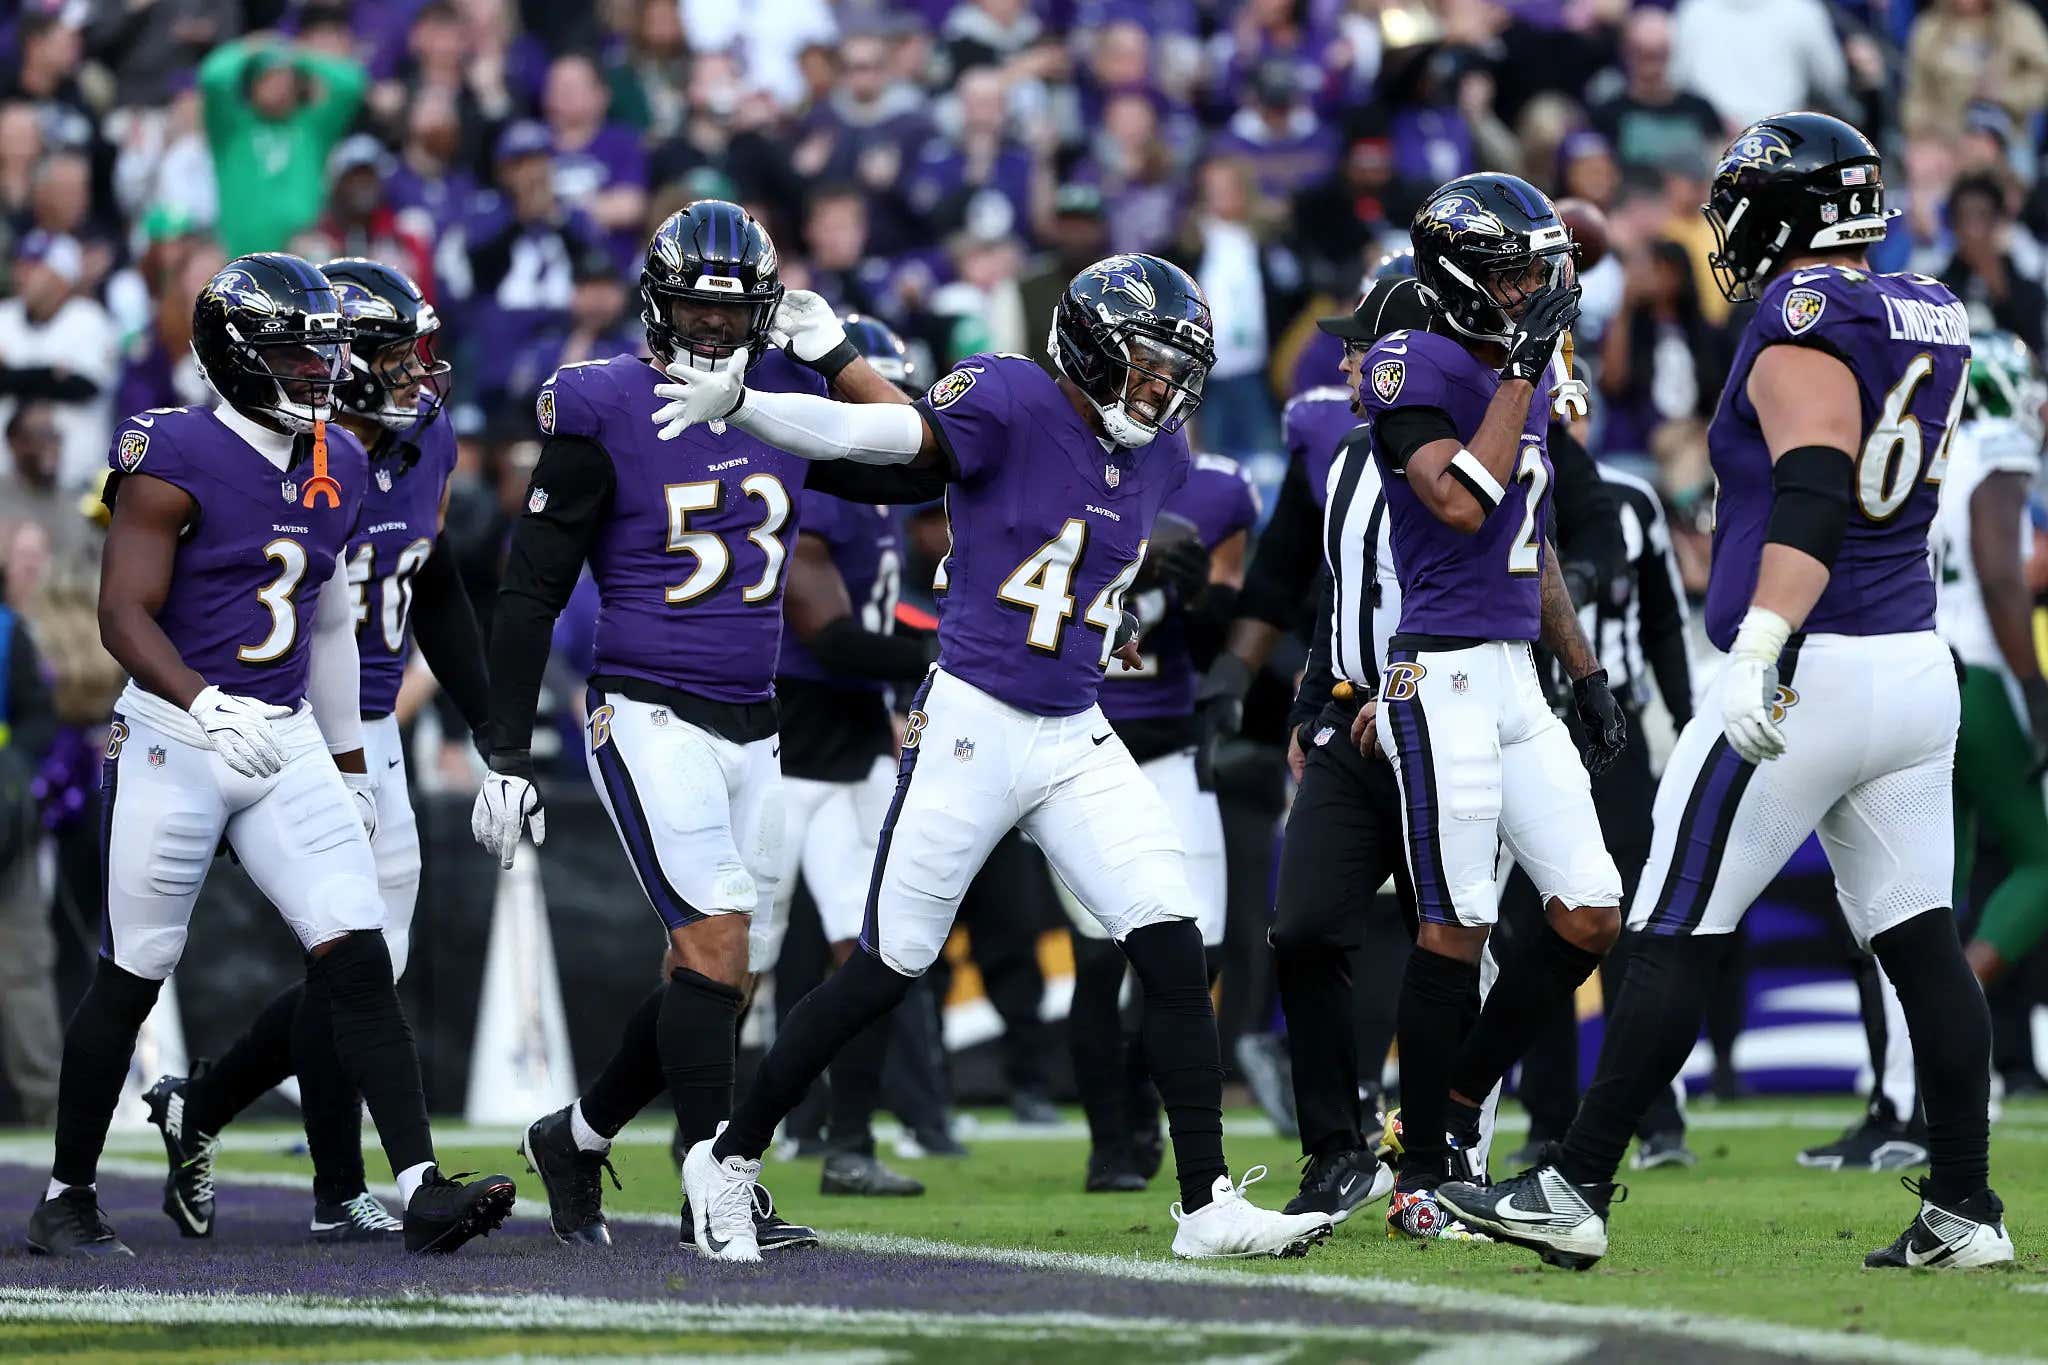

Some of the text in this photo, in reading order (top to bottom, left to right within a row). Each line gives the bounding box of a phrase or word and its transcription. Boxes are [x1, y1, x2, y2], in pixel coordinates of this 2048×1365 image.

[1856, 352, 1971, 522] 64
[707, 457, 749, 472] RAVENS
[368, 521, 408, 535] RAVENS
[1085, 504, 1121, 522] RAVENS
[1507, 444, 1549, 573] 2
[271, 523, 309, 535] RAVENS
[663, 472, 790, 603] 53
[236, 537, 308, 663] 3
[997, 518, 1149, 666] 44
[1384, 661, 1427, 701] B
[105, 721, 130, 760] B
[901, 709, 929, 749] B
[165, 1091, 185, 1140] NIKE
[1531, 1225, 1574, 1236] FORCE
